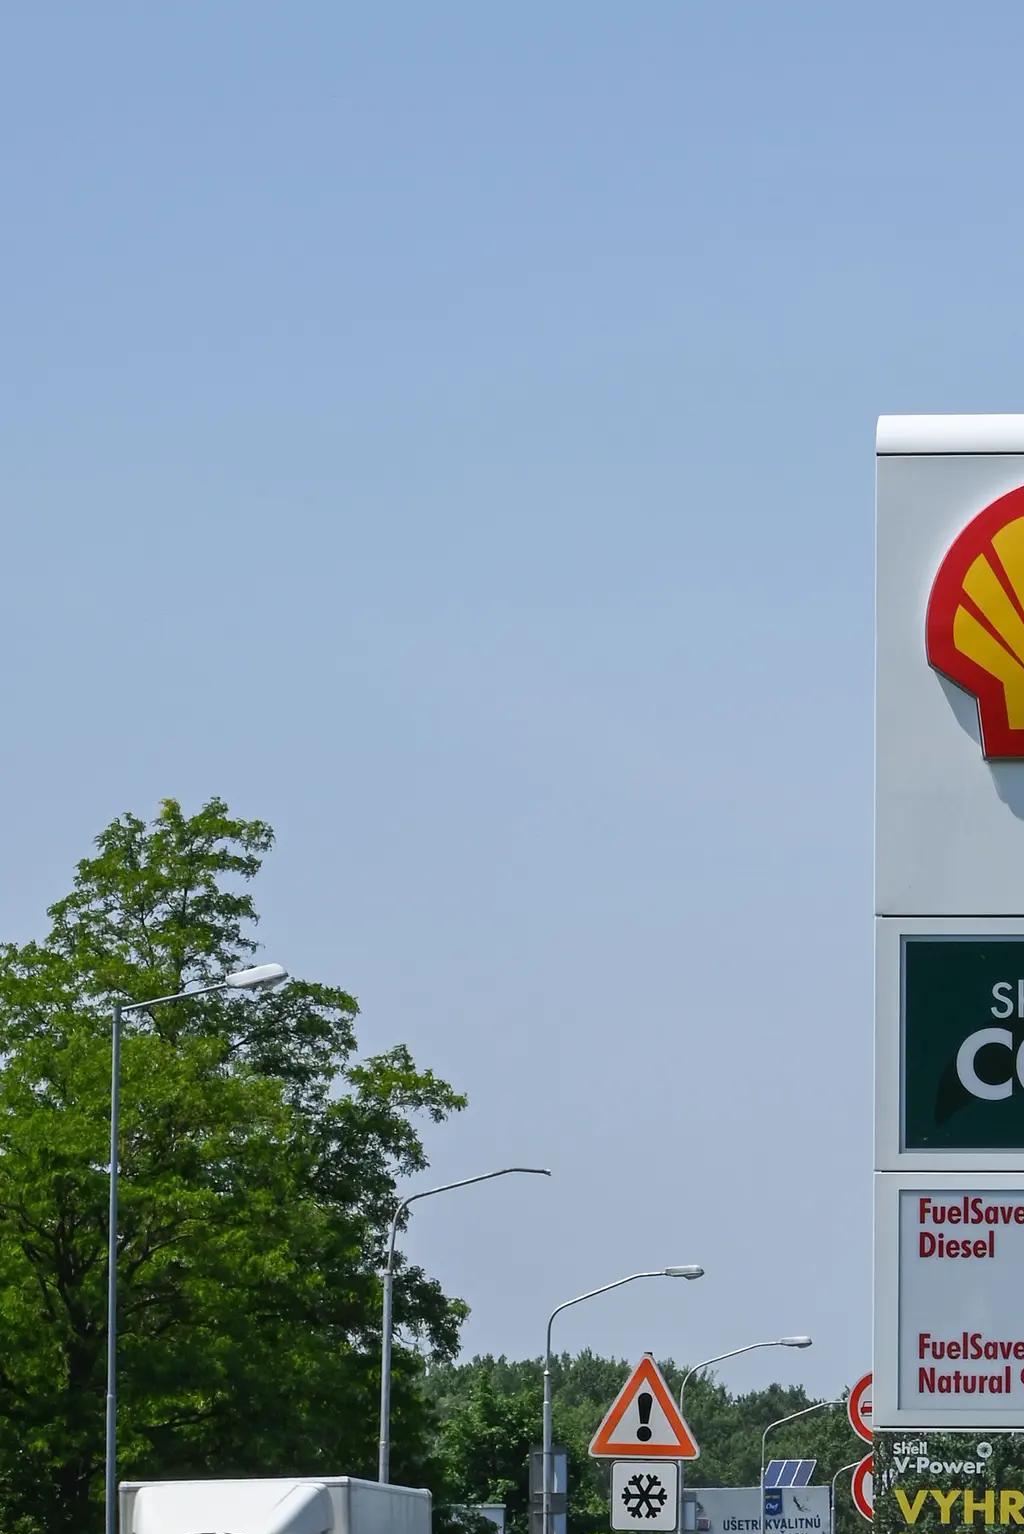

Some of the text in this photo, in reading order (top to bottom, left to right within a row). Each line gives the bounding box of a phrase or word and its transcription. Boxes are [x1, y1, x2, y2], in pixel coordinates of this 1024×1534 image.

[918, 1230, 995, 1258] Diesel
[918, 1366, 1011, 1394] Natural
[893, 1441, 928, 1455] Shell
[893, 1456, 985, 1474] V-Power
[765, 1514, 821, 1530] KVALITNÚ
